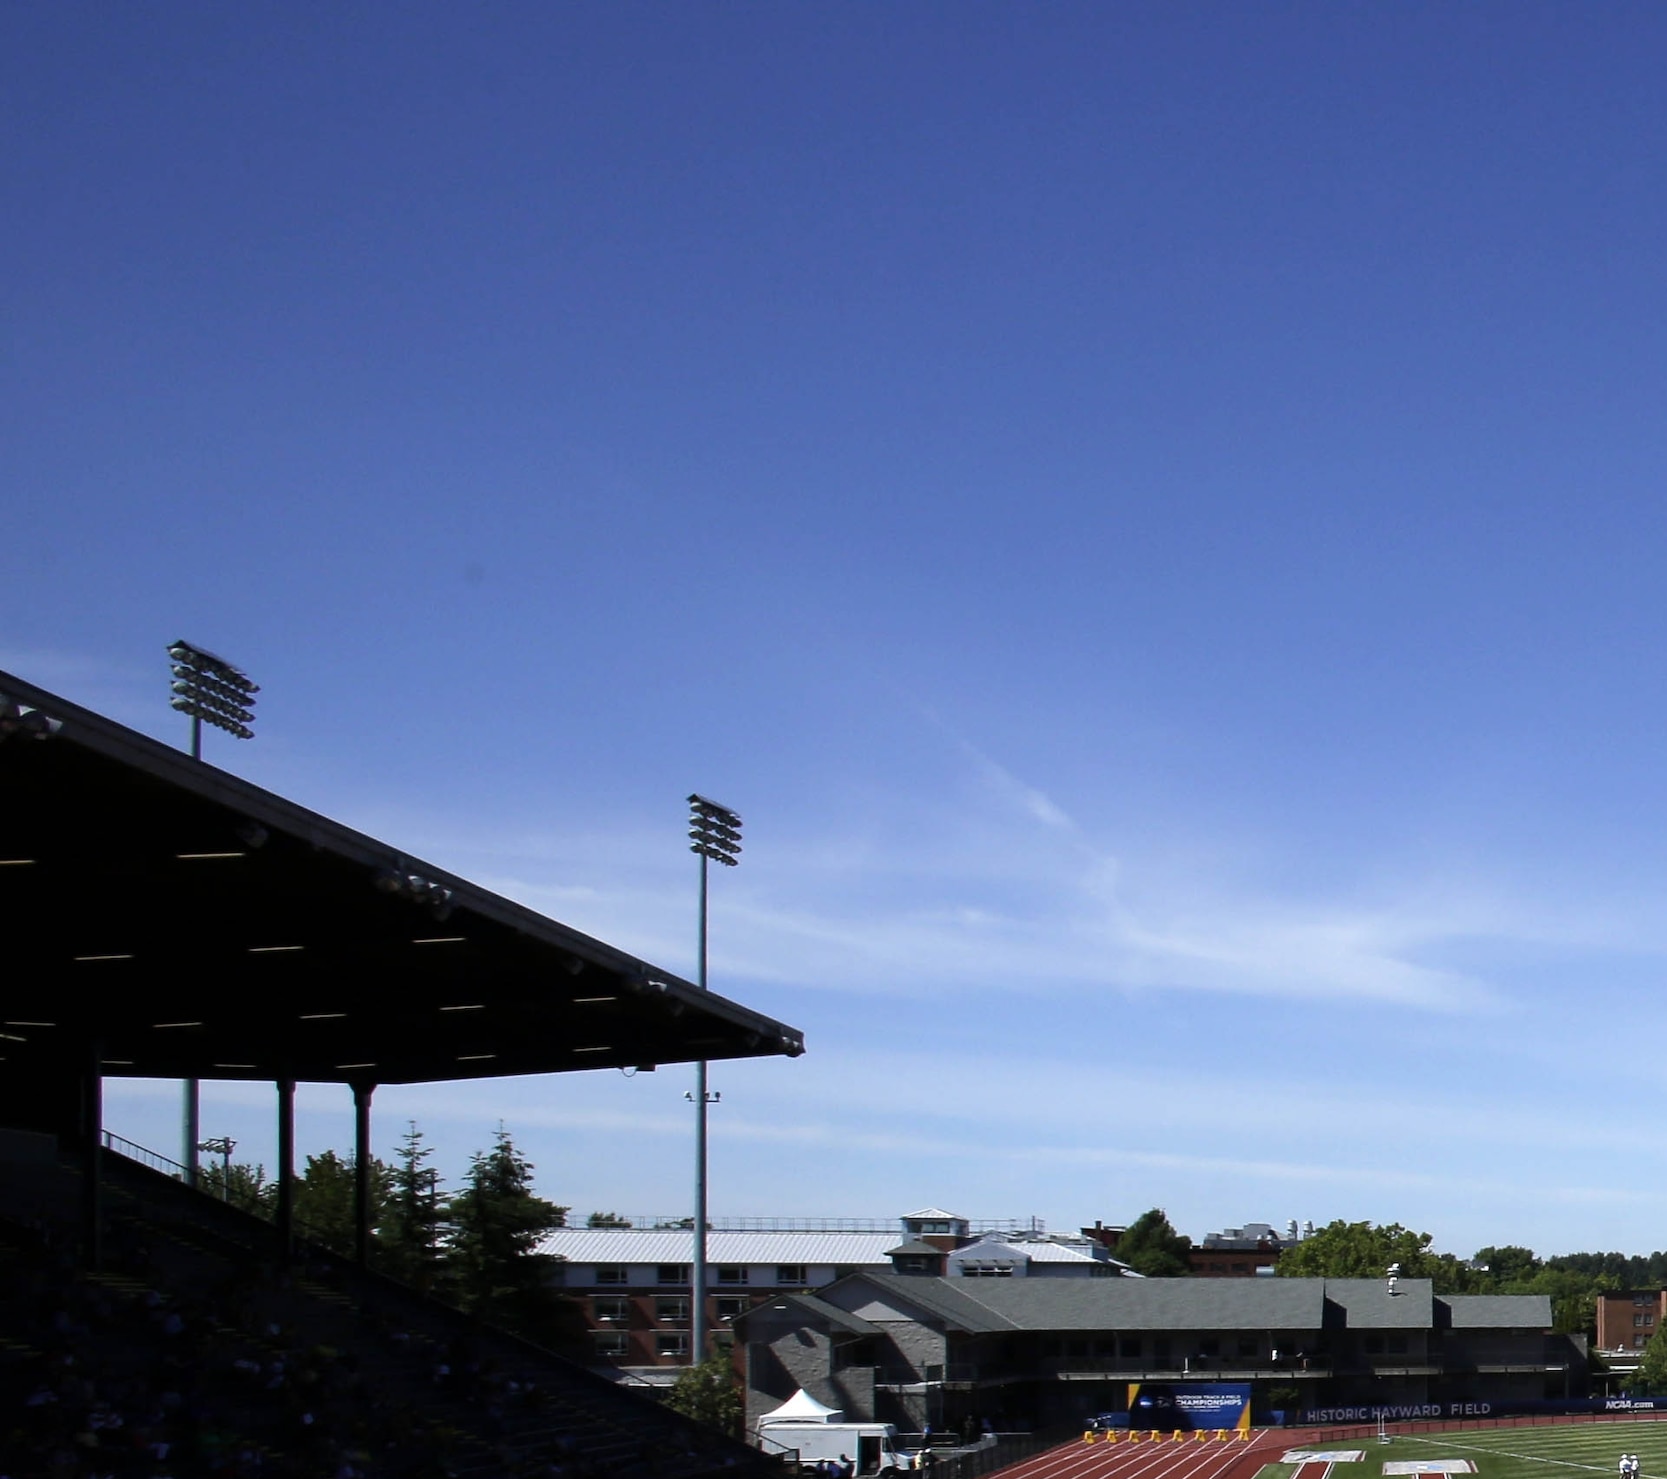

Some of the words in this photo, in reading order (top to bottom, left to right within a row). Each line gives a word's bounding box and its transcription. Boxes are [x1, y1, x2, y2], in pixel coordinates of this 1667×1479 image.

[1605, 1400, 1654, 1409] NCAA.com
[1306, 1408, 1367, 1422] HISTORIC
[1371, 1405, 1441, 1420] HAYWARD
[1451, 1403, 1490, 1416] FIELD
